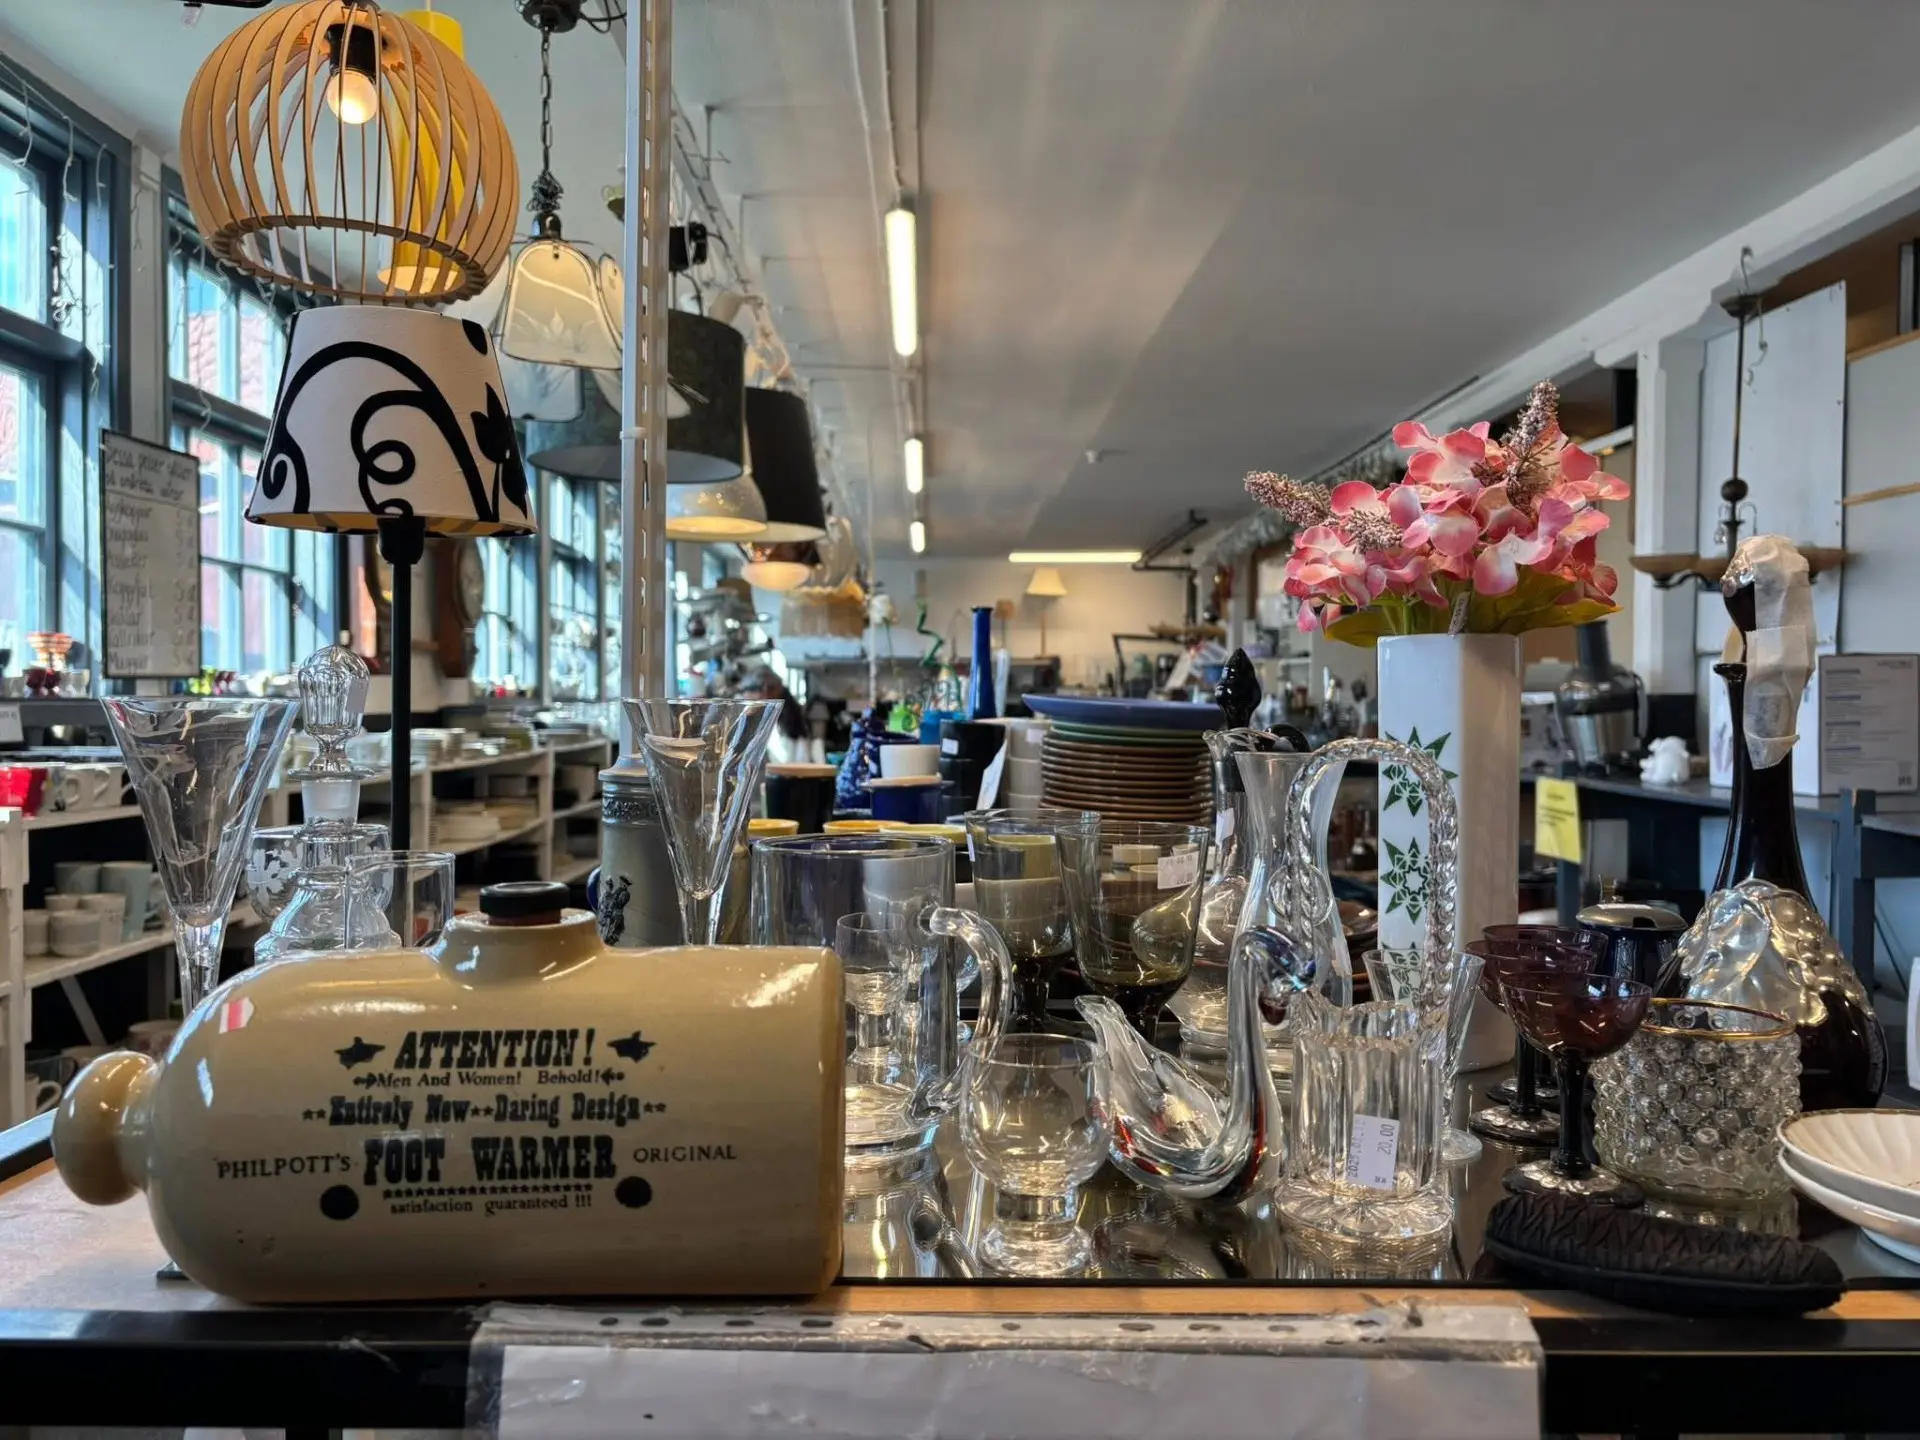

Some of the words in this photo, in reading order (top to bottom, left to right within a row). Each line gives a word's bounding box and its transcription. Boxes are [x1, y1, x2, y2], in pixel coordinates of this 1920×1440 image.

[394, 1029, 595, 1069] ATTENTION!
[377, 1072, 412, 1088] Men
[417, 1071, 450, 1087] And
[458, 1070, 521, 1086] Women!
[538, 1069, 600, 1085] Behold!
[329, 1095, 413, 1129] Entirely
[494, 1093, 560, 1128] Daring
[571, 1091, 641, 1127] Design
[216, 1153, 350, 1180] PHILPOTT'S
[363, 1137, 445, 1186] FOOT
[471, 1135, 616, 1182] WARMER
[633, 1144, 737, 1164] ORIGINAL
[390, 1198, 473, 1216] satisfaction
[485, 1194, 568, 1217] guaranteed
